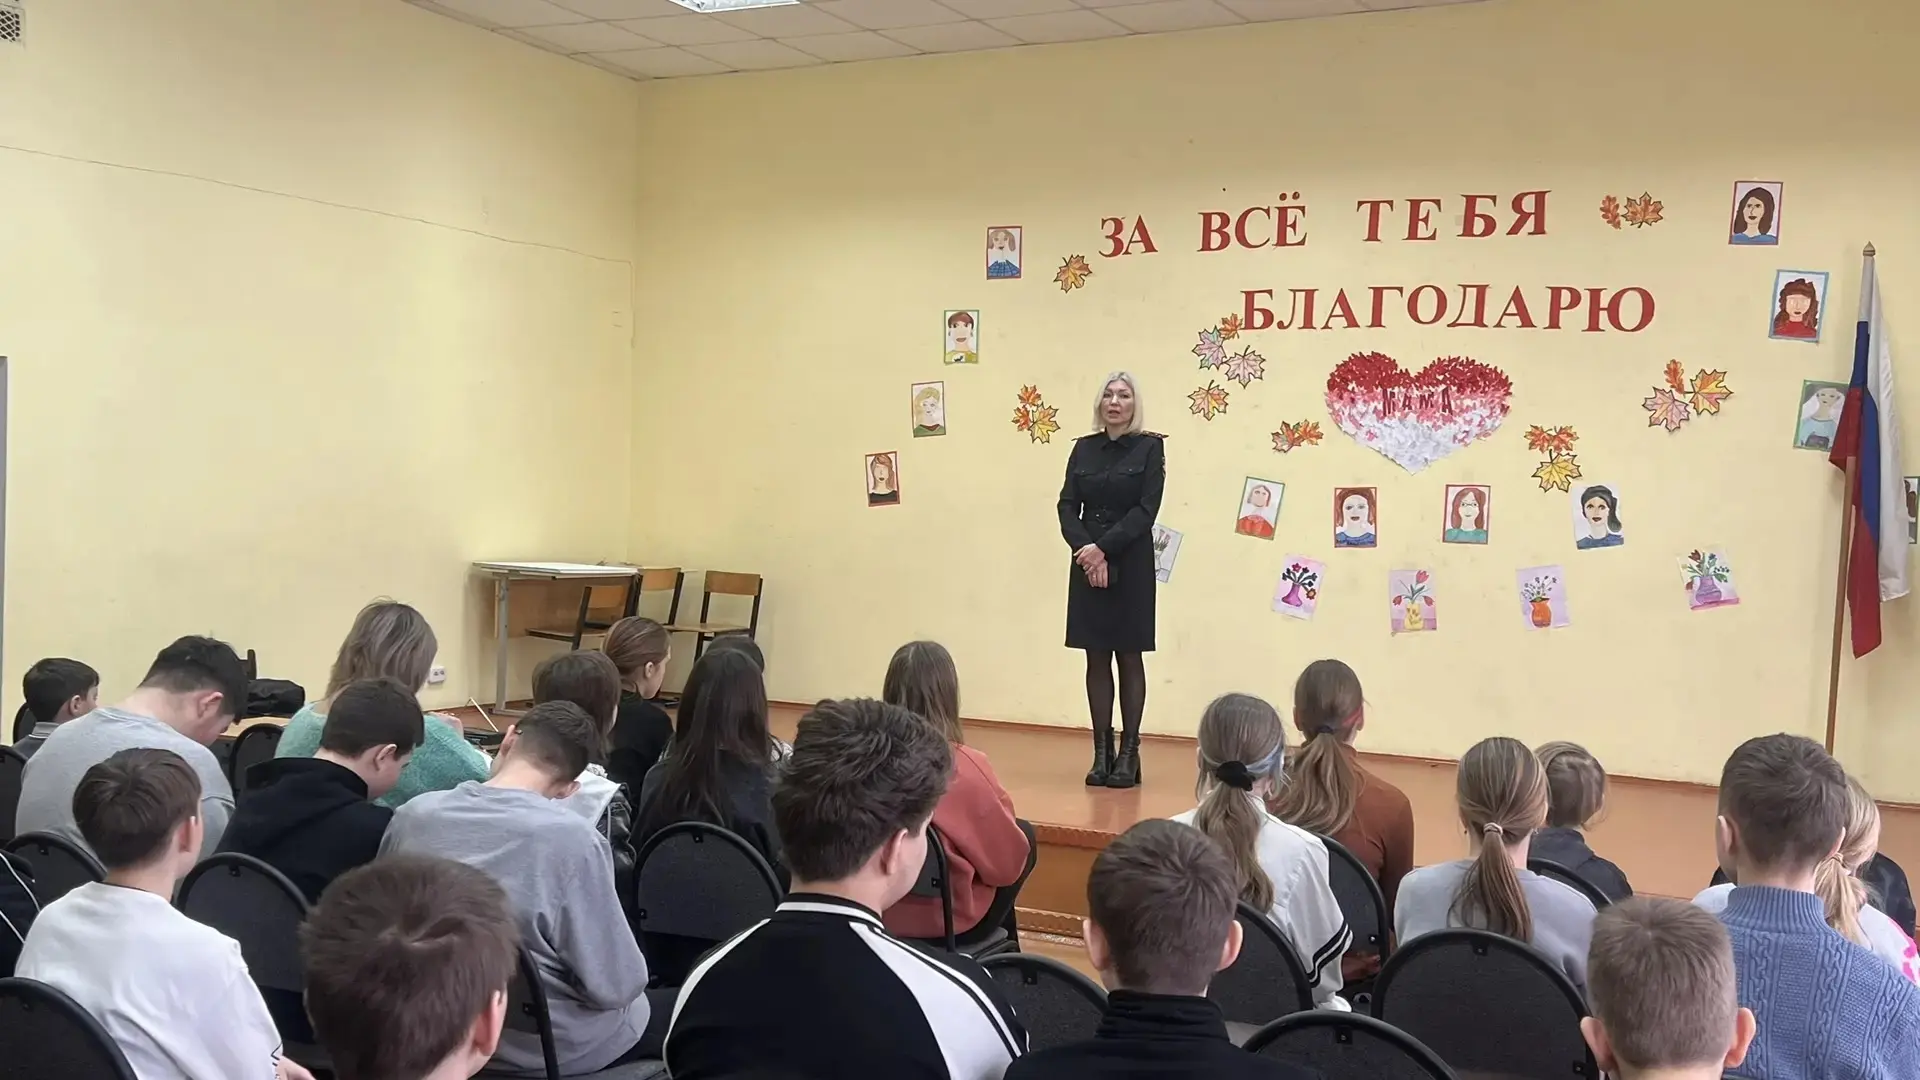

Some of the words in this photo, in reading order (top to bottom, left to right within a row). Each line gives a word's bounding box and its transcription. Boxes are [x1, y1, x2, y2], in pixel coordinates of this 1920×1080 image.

[1098, 215, 1159, 258] ЗА
[1197, 191, 1308, 253] ВСЁ
[1357, 190, 1552, 242] ТЕБЯ
[1241, 284, 1656, 333] БЛАГОДАРЮ
